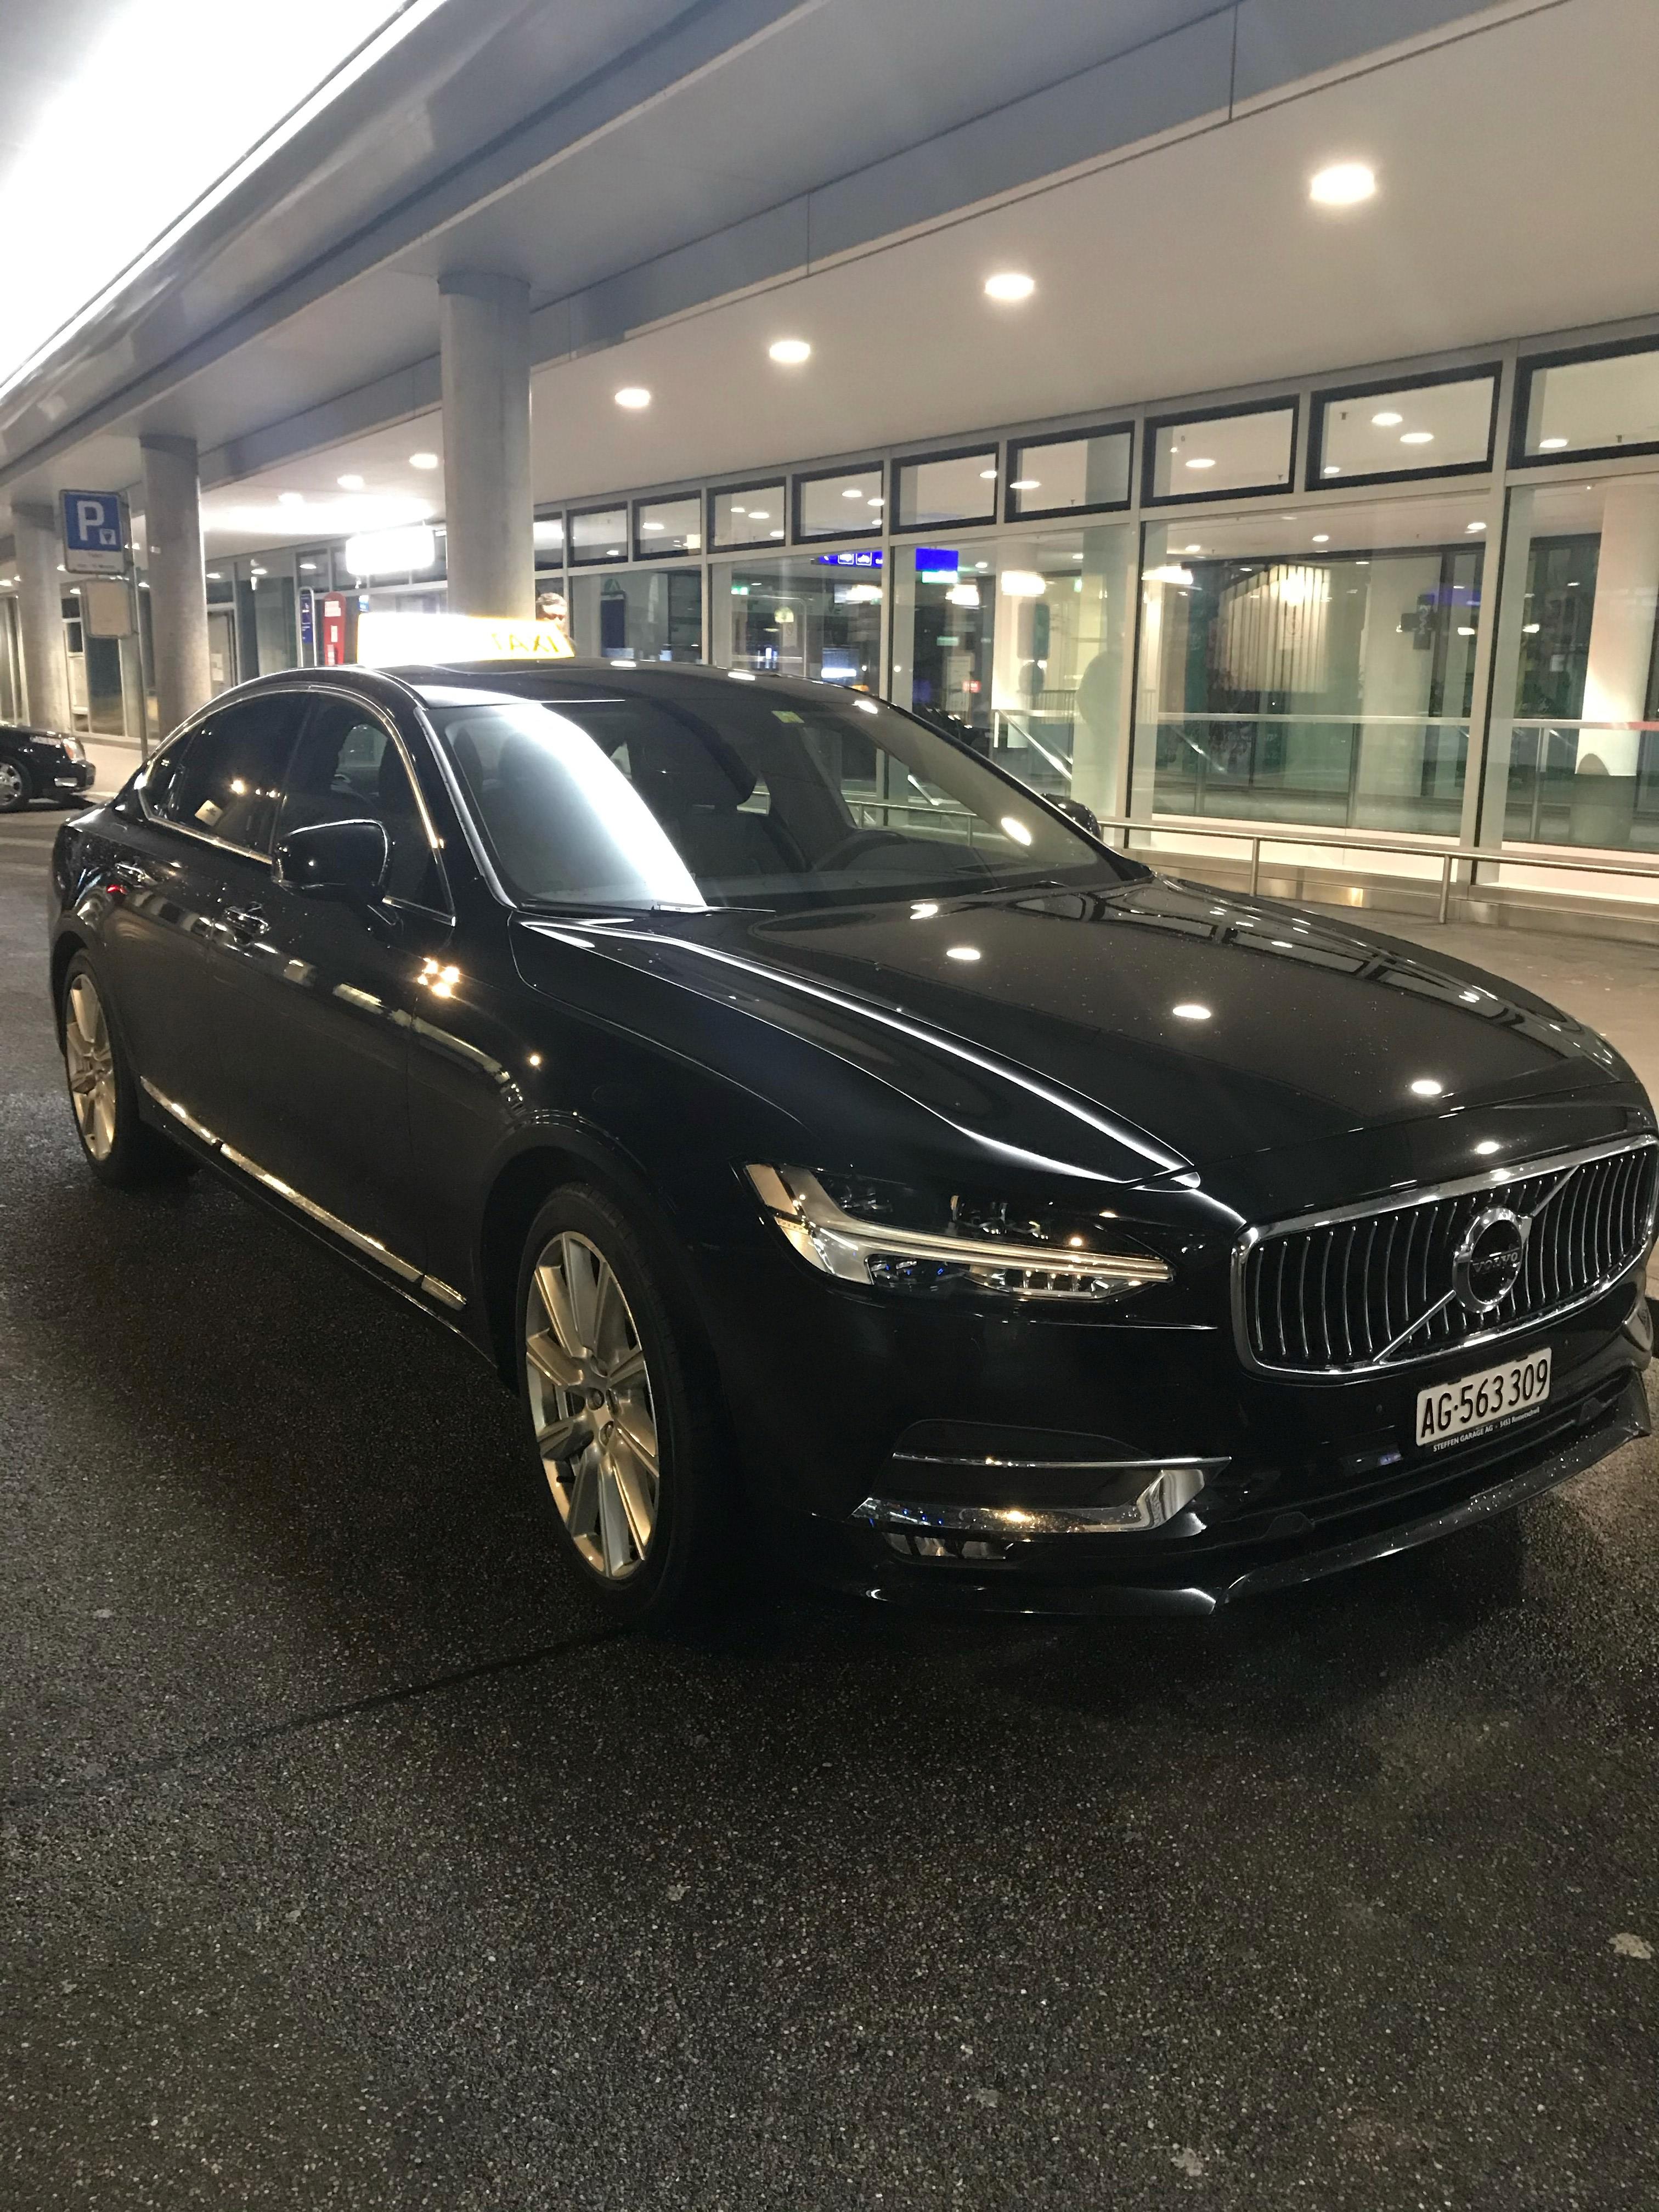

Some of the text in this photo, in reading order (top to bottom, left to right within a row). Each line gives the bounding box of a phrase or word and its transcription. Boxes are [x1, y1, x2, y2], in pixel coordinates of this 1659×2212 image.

[77, 500, 104, 541] P
[1433, 1437, 1459, 1452] STEFFEN
[1460, 1427, 1484, 1442] GARAGE
[1485, 1425, 1493, 1434] AG
